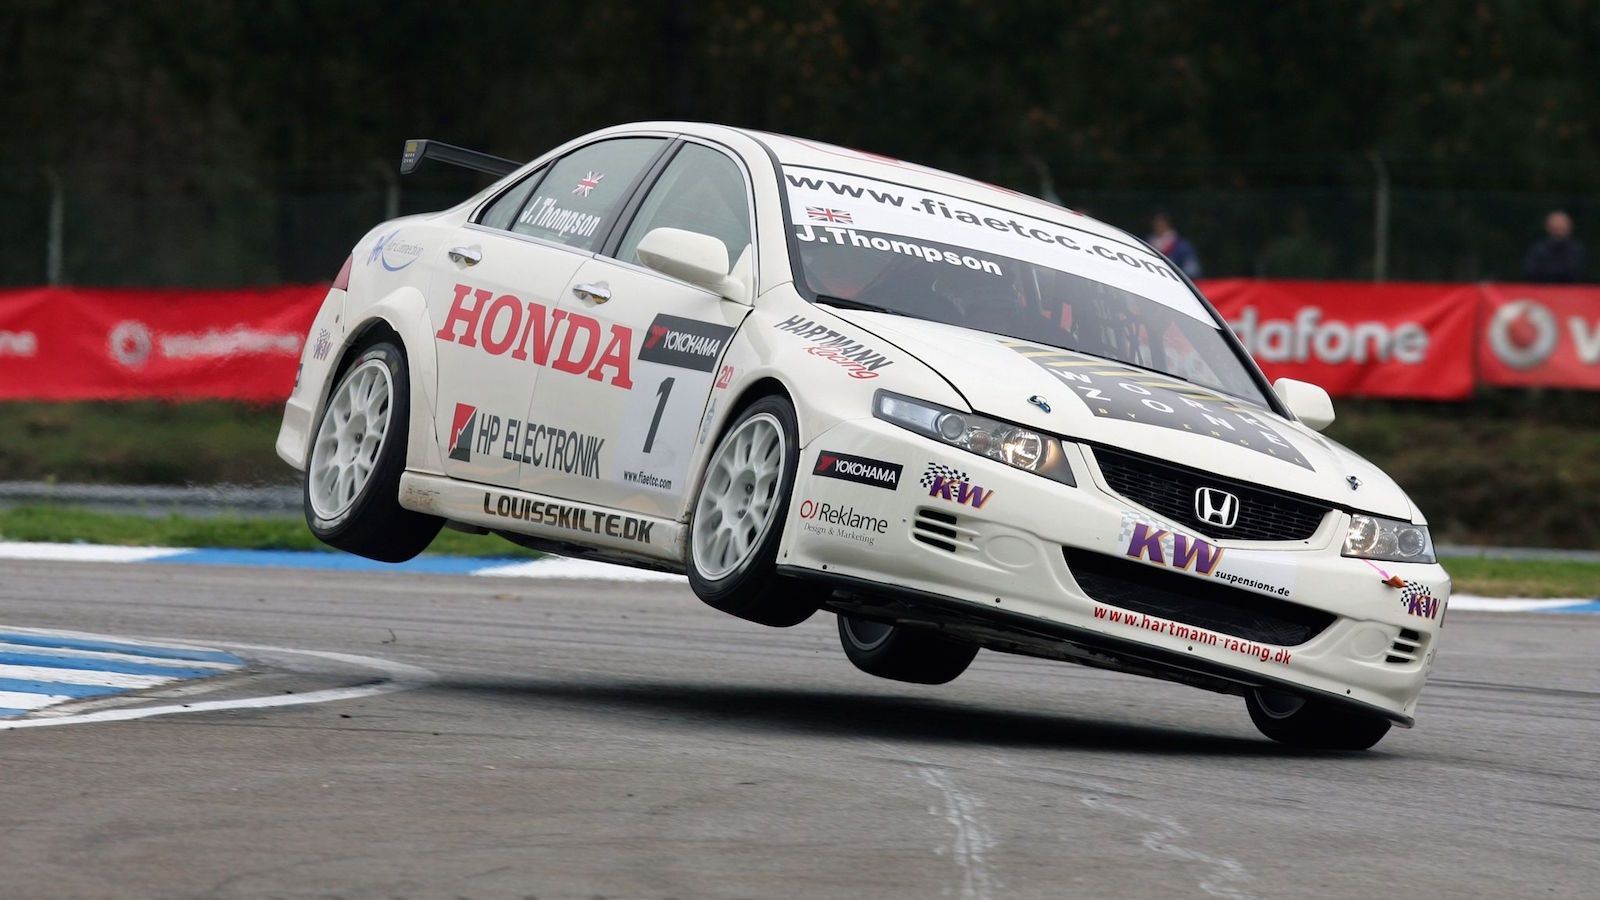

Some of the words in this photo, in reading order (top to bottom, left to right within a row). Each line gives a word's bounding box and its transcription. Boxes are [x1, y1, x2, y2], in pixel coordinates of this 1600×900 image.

[520, 196, 601, 237] J.Thompson
[785, 174, 1181, 283] www.fiaetcc.com
[796, 225, 1003, 277] J.Thompson
[436, 283, 634, 390] HONDA
[663, 329, 722, 359] YOKOHAMA
[774, 315, 895, 372] HARTMANN
[803, 343, 880, 379] Racing
[642, 376, 676, 455] 1
[1050, 368, 1270, 431] WORK
[1078, 386, 1291, 449] ZONE
[476, 412, 501, 456] HP
[502, 419, 606, 480] ELECTRONIK
[834, 458, 897, 484] YOKOHAMA
[623, 470, 672, 490] www.fiaetcc.com
[928, 474, 995, 509] KW
[483, 492, 655, 544] LOUISSKILTE.DK
[804, 522, 827, 536] Design
[827, 527, 835, 536] &
[837, 528, 876, 545] Marketing
[819, 503, 888, 534] Reklame
[1126, 521, 1225, 577] KW
[1215, 569, 1291, 597] suspensions.de
[1408, 592, 1441, 620] KW
[1093, 604, 1293, 665] www.hartmann-racing.dk
